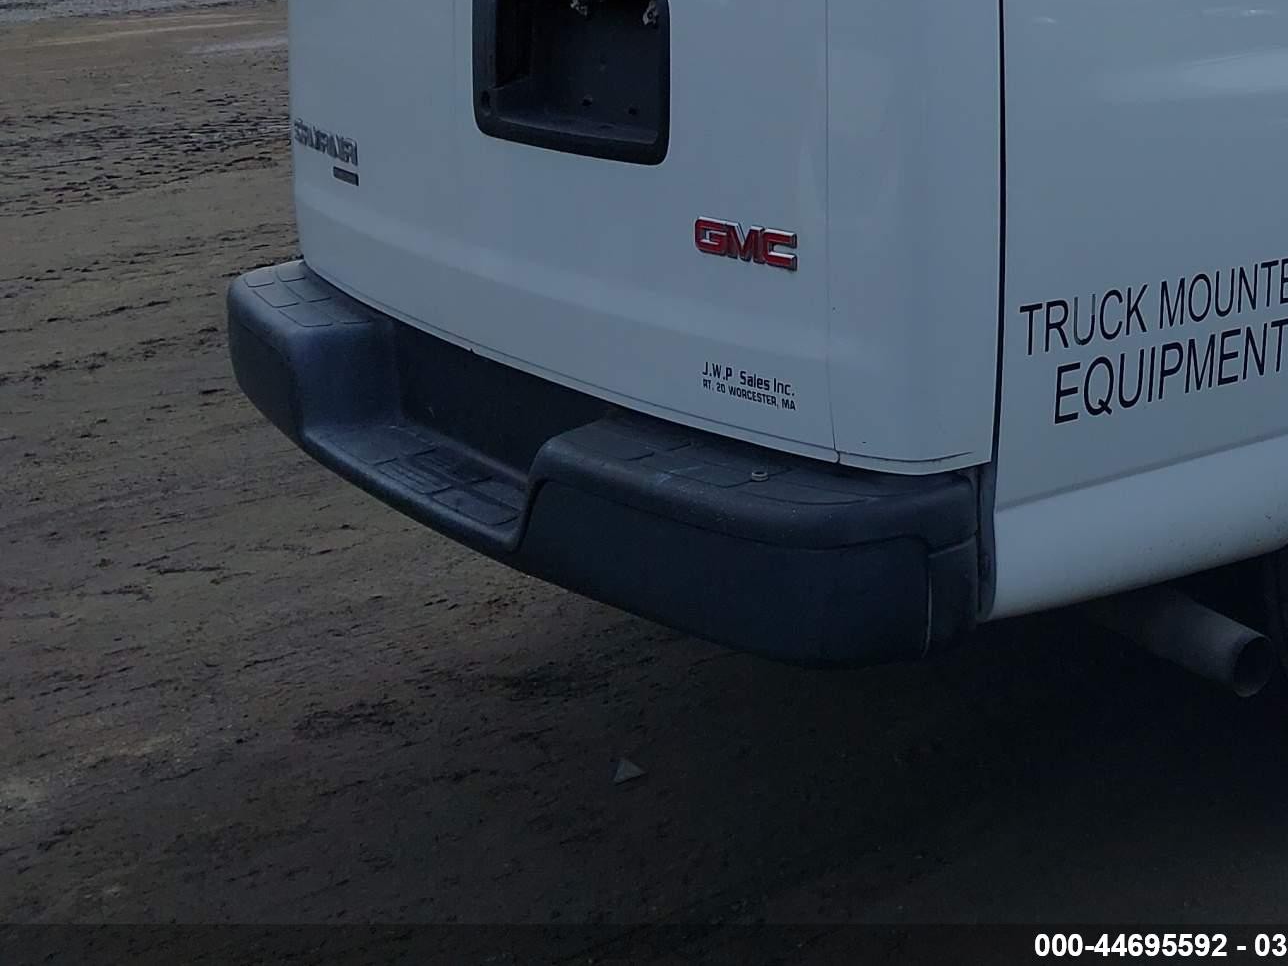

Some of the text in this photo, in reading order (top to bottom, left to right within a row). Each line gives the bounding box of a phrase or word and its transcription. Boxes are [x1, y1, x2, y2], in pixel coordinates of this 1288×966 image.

[695, 216, 797, 271] GMC
[1019, 284, 1148, 356] TRUCK
[717, 382, 726, 394] 20
[729, 386, 779, 409] WORCESTER,
[782, 398, 796, 411] MA
[740, 371, 770, 392] Sales
[774, 378, 795, 397] Inc.
